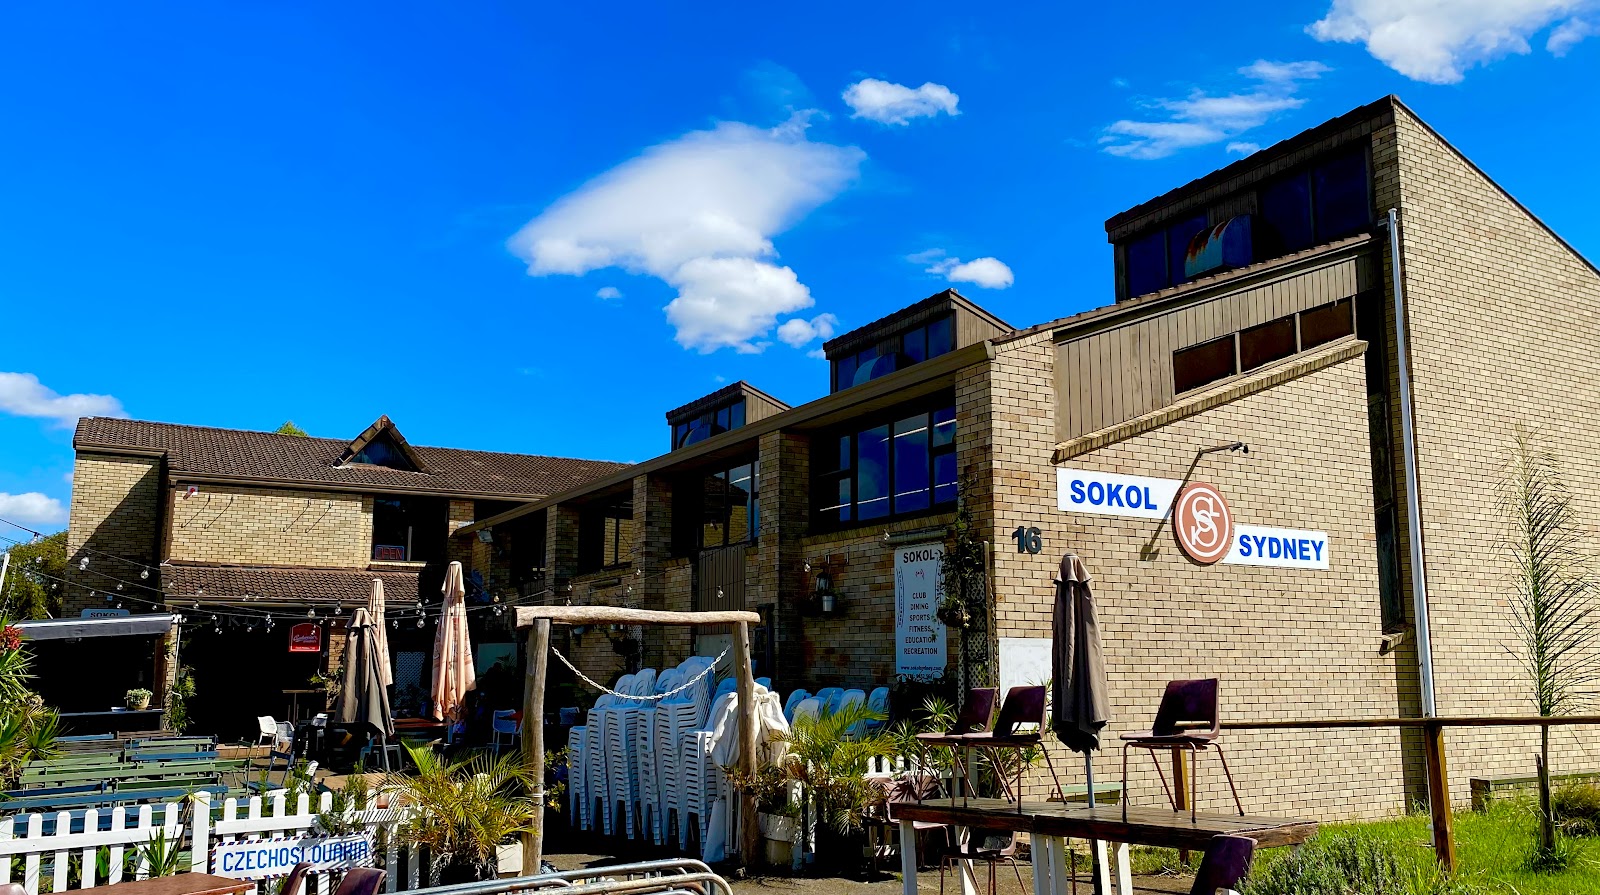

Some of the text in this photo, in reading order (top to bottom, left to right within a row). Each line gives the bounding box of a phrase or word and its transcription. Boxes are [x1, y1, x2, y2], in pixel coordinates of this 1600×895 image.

[1070, 480, 1158, 511] SOKOL
[1012, 526, 1042, 554] 16
[1239, 534, 1324, 561] SYDNEY
[903, 549, 935, 563] SOKOL
[910, 602, 929, 610] DINING
[909, 613, 930, 621] SPORTS
[903, 647, 938, 655] RECREATION
